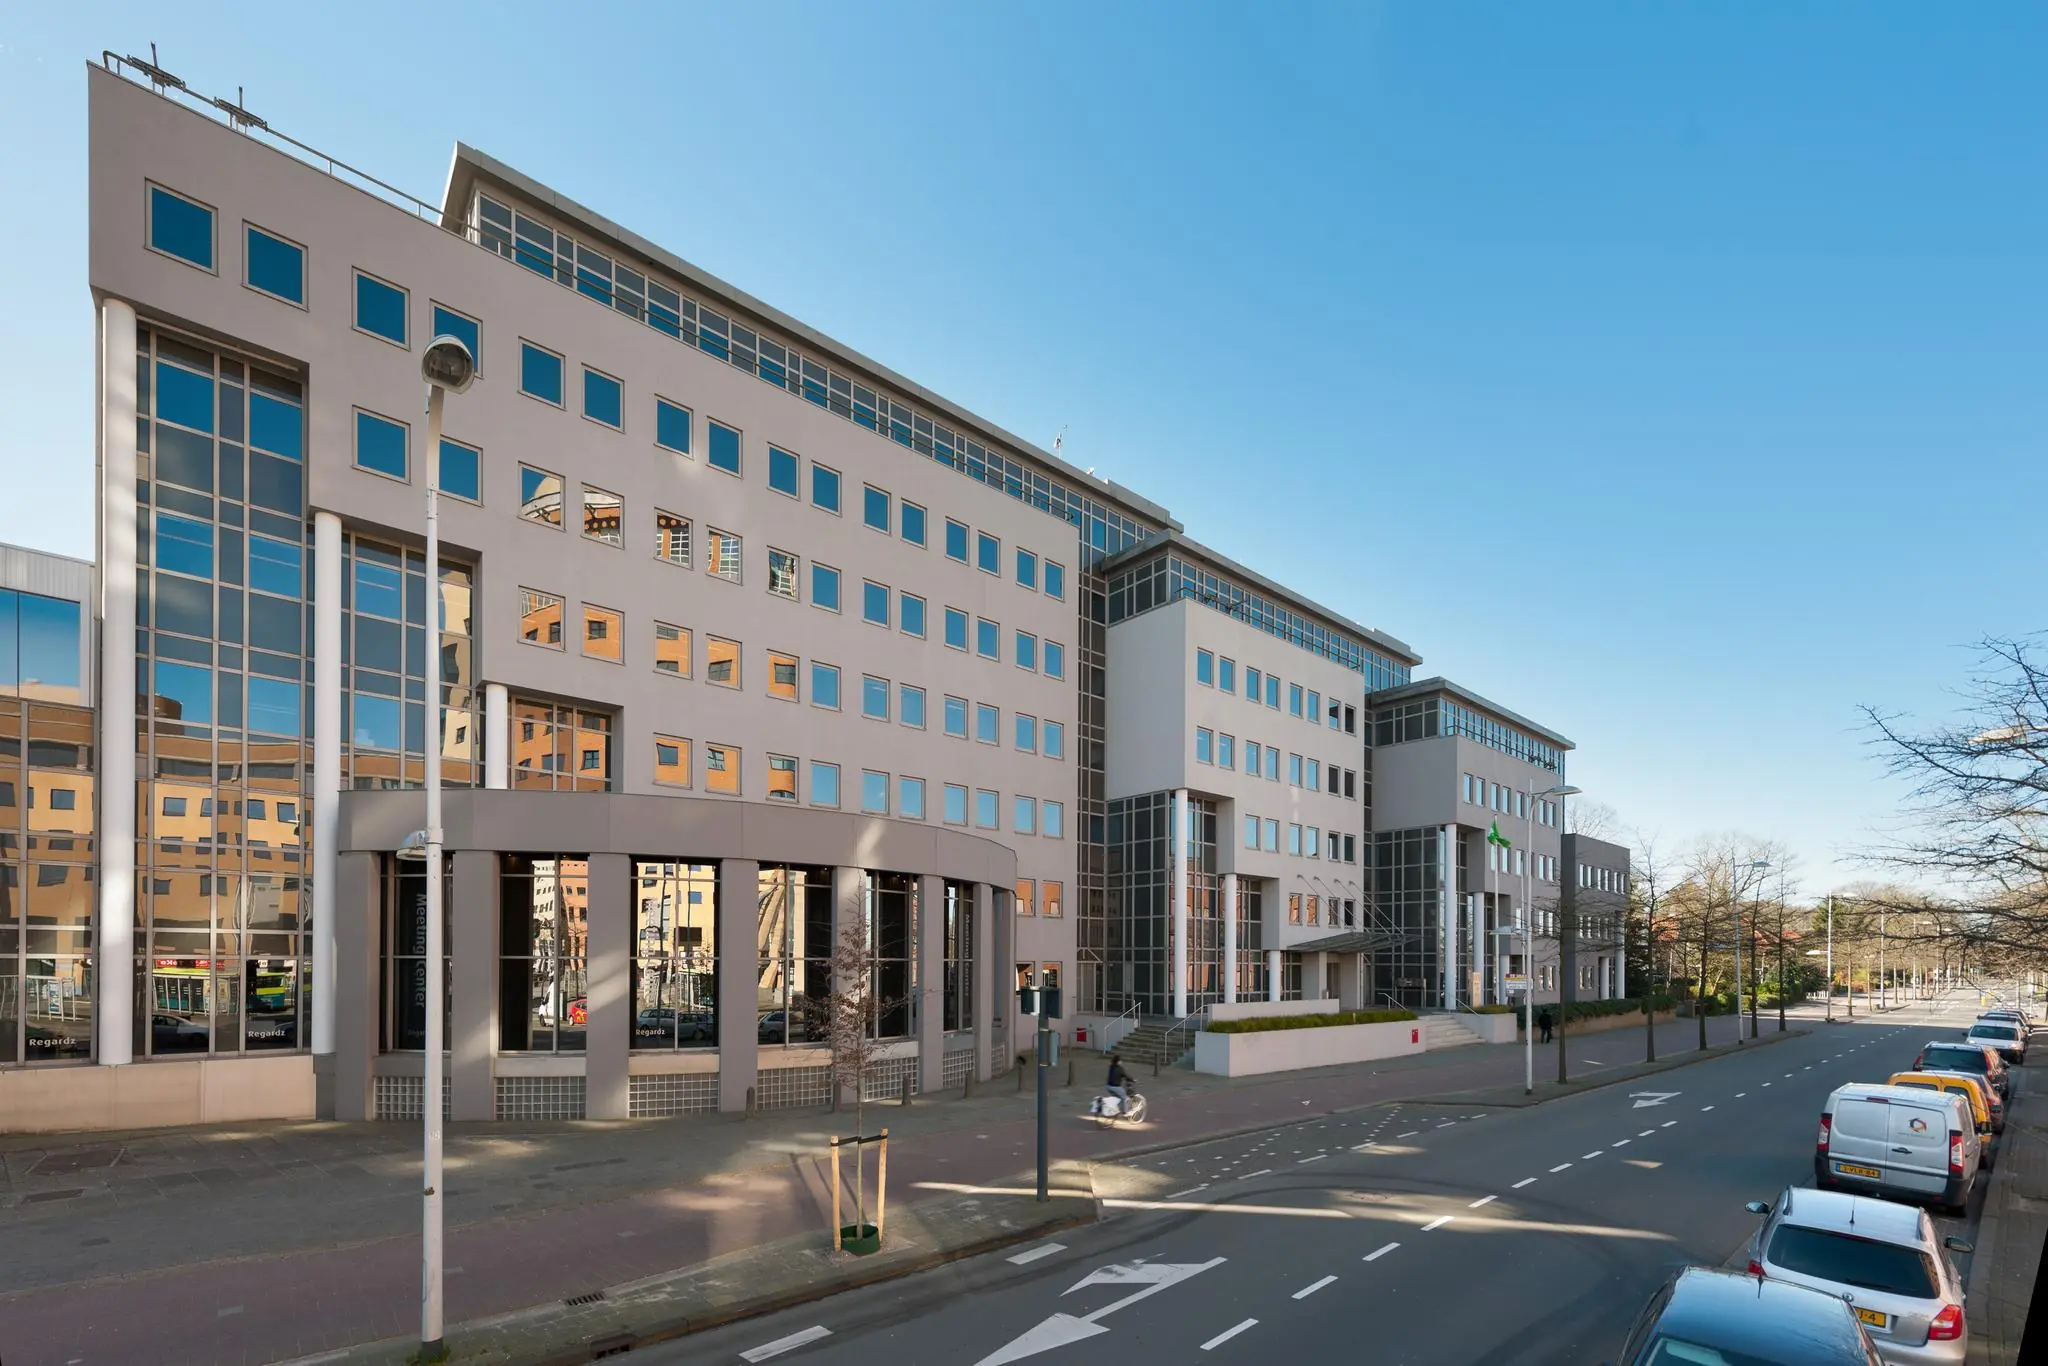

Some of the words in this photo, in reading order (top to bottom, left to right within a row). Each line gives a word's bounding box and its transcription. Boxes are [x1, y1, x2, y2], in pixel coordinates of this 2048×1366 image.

[412, 893, 427, 954] Meeting
[415, 960, 427, 1008] Center
[248, 1029, 286, 1039] Regardz
[635, 1028, 665, 1037] Regardz
[29, 1036, 77, 1047] Regardz
